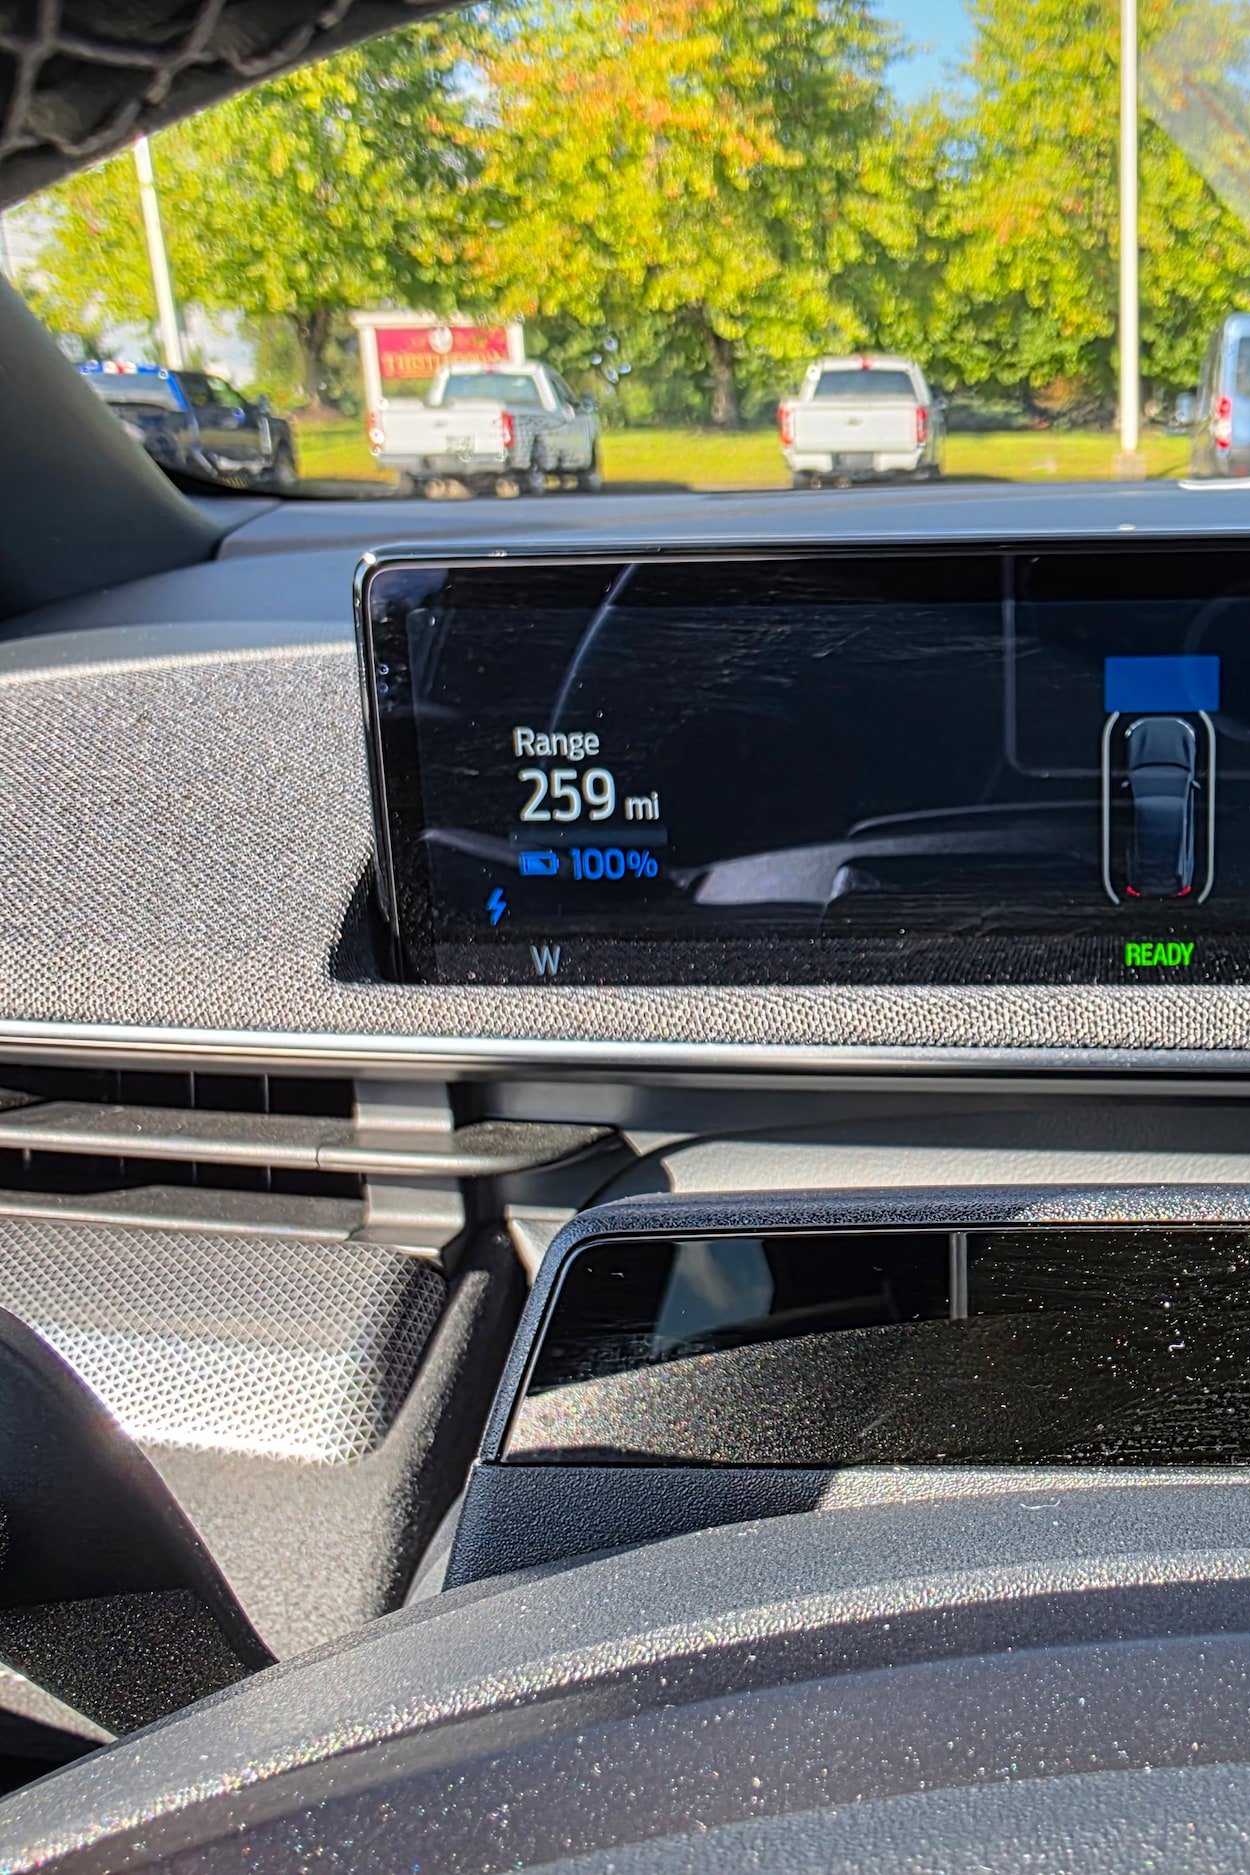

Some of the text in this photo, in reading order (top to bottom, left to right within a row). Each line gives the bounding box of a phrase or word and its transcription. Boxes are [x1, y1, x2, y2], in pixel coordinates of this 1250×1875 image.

[512, 725, 601, 762] Range
[518, 767, 660, 822] 259 mi
[570, 848, 659, 881] 100%
[530, 945, 561, 977] W
[1124, 941, 1195, 968] READY
